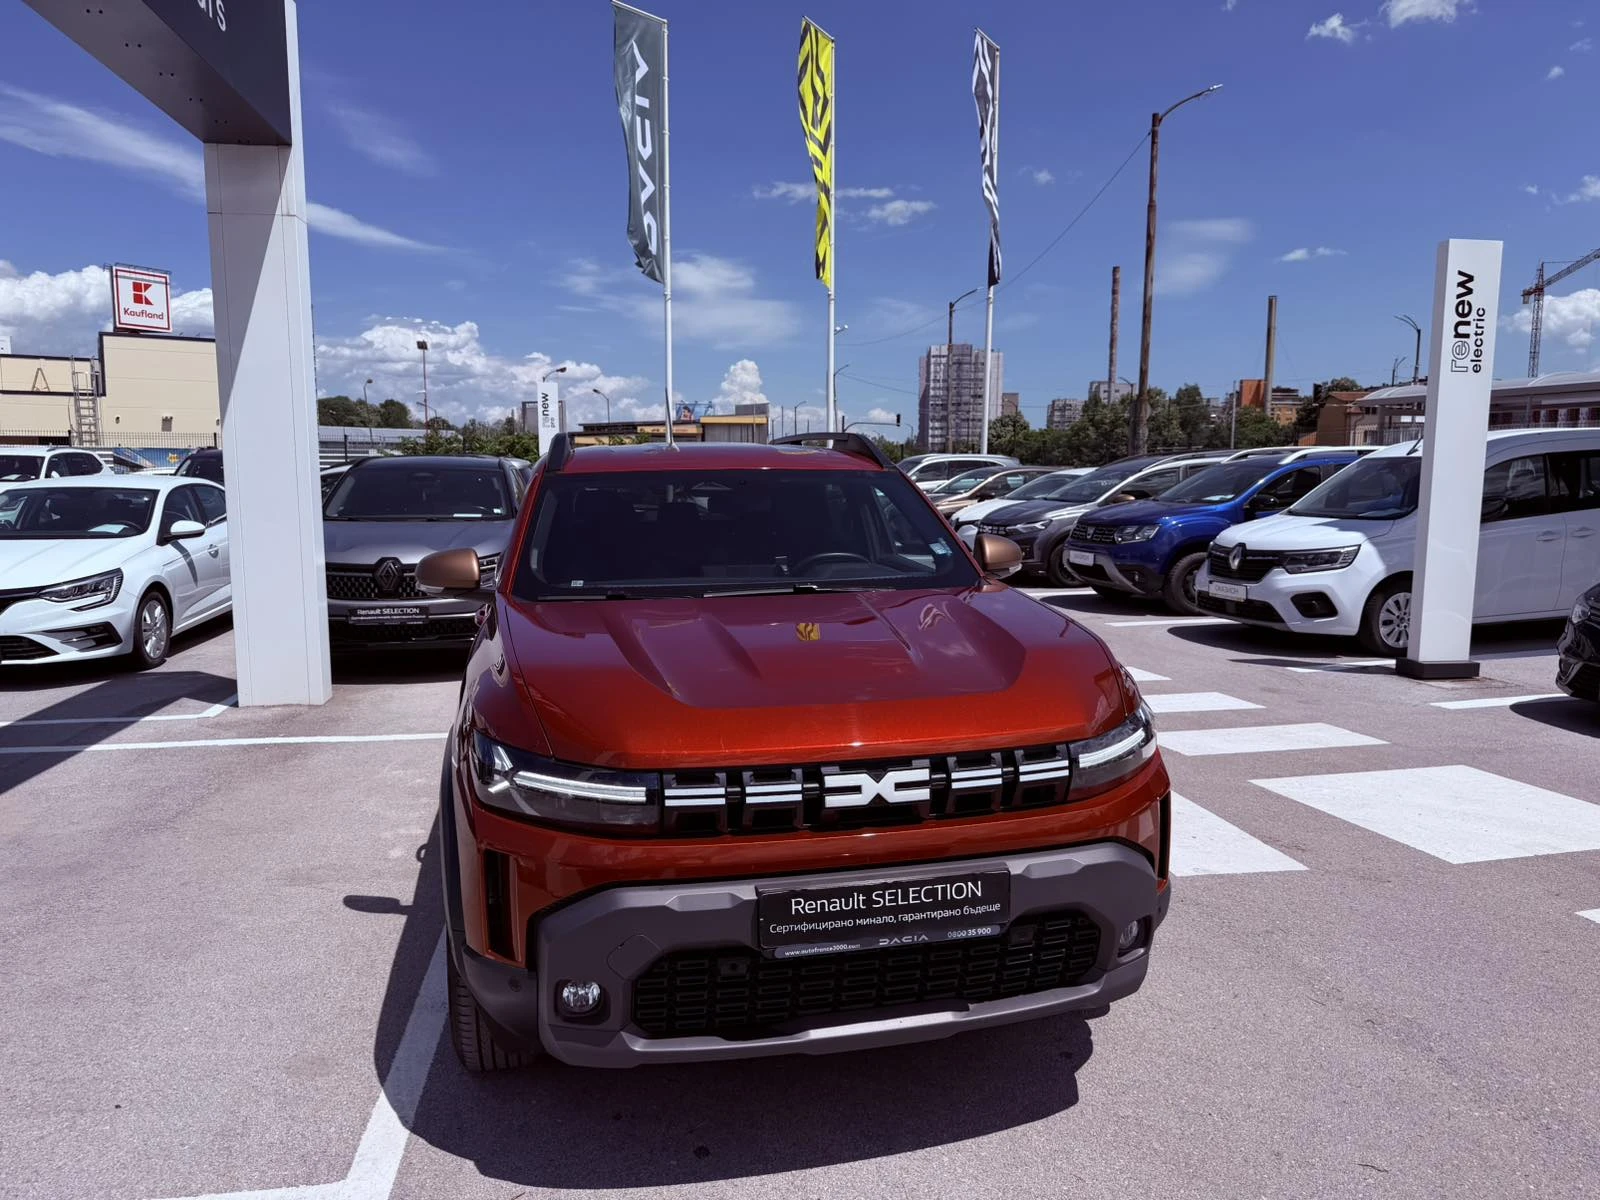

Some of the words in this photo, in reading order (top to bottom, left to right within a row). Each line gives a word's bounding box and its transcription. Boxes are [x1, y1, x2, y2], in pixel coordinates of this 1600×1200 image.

[123, 307, 165, 320] Kaufland
[1451, 269, 1475, 373] renew
[1470, 307, 1486, 374] electric
[382, 607, 420, 615] SELECTION
[791, 892, 867, 916] Renault
[872, 880, 983, 908] SELECTION
[769, 918, 854, 935] Сертифицирано
[856, 914, 898, 926] минало,
[898, 907, 962, 923] гарантирано
[963, 902, 1001, 916] бъдеще
[879, 934, 929, 946] DACIA
[947, 929, 967, 938] 0800
[967, 928, 977, 936] 35
[977, 927, 992, 935] 900
